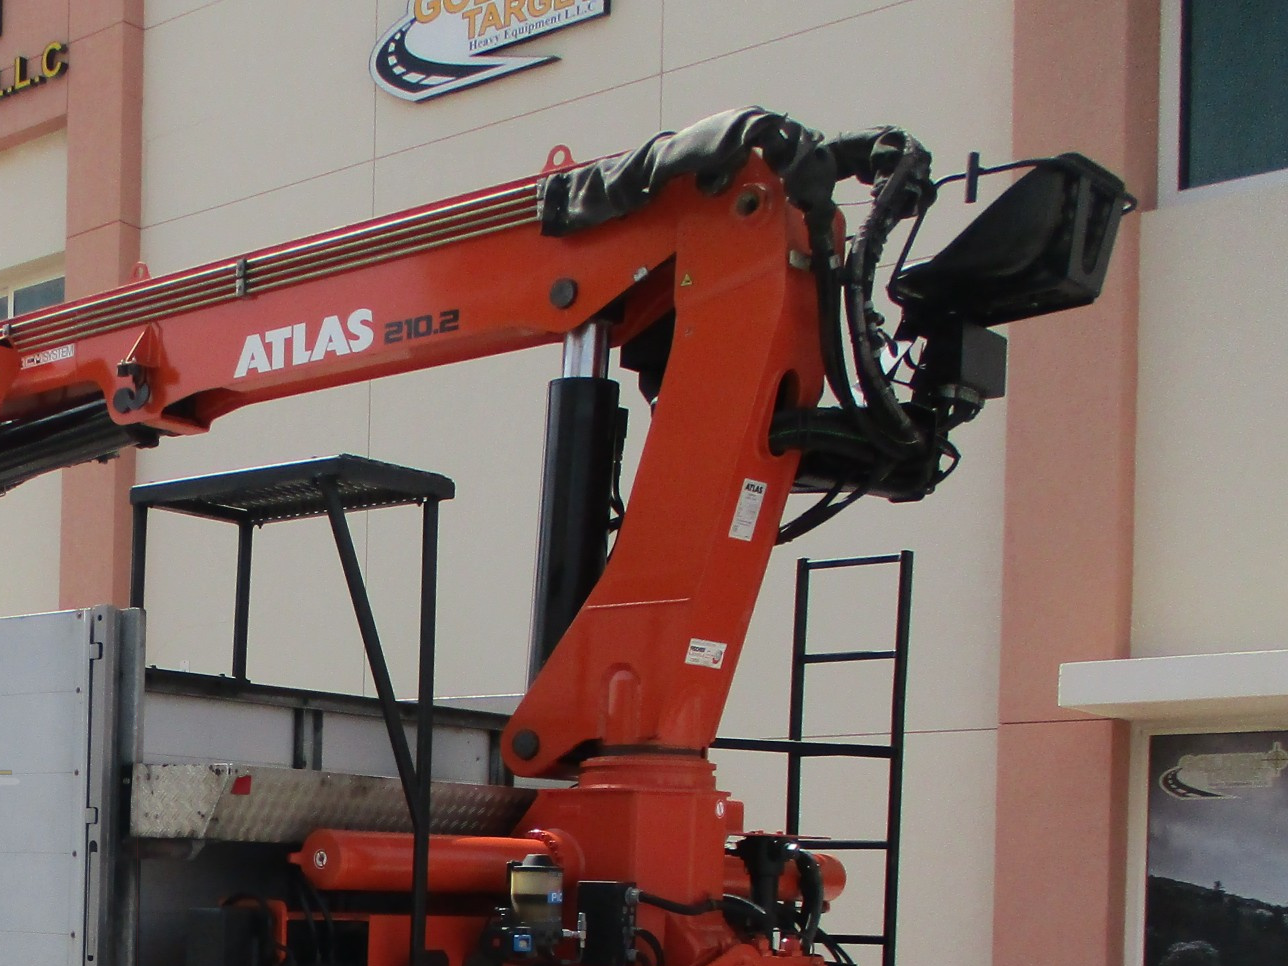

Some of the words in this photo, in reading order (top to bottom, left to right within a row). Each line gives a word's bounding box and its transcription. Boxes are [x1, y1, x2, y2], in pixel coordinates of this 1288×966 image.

[469, 33, 499, 50] Heavy
[504, 13, 561, 39] Equipment
[233, 308, 374, 379] ATLAS
[384, 309, 460, 345] 210.2
[745, 483, 763, 494] ATLAS
